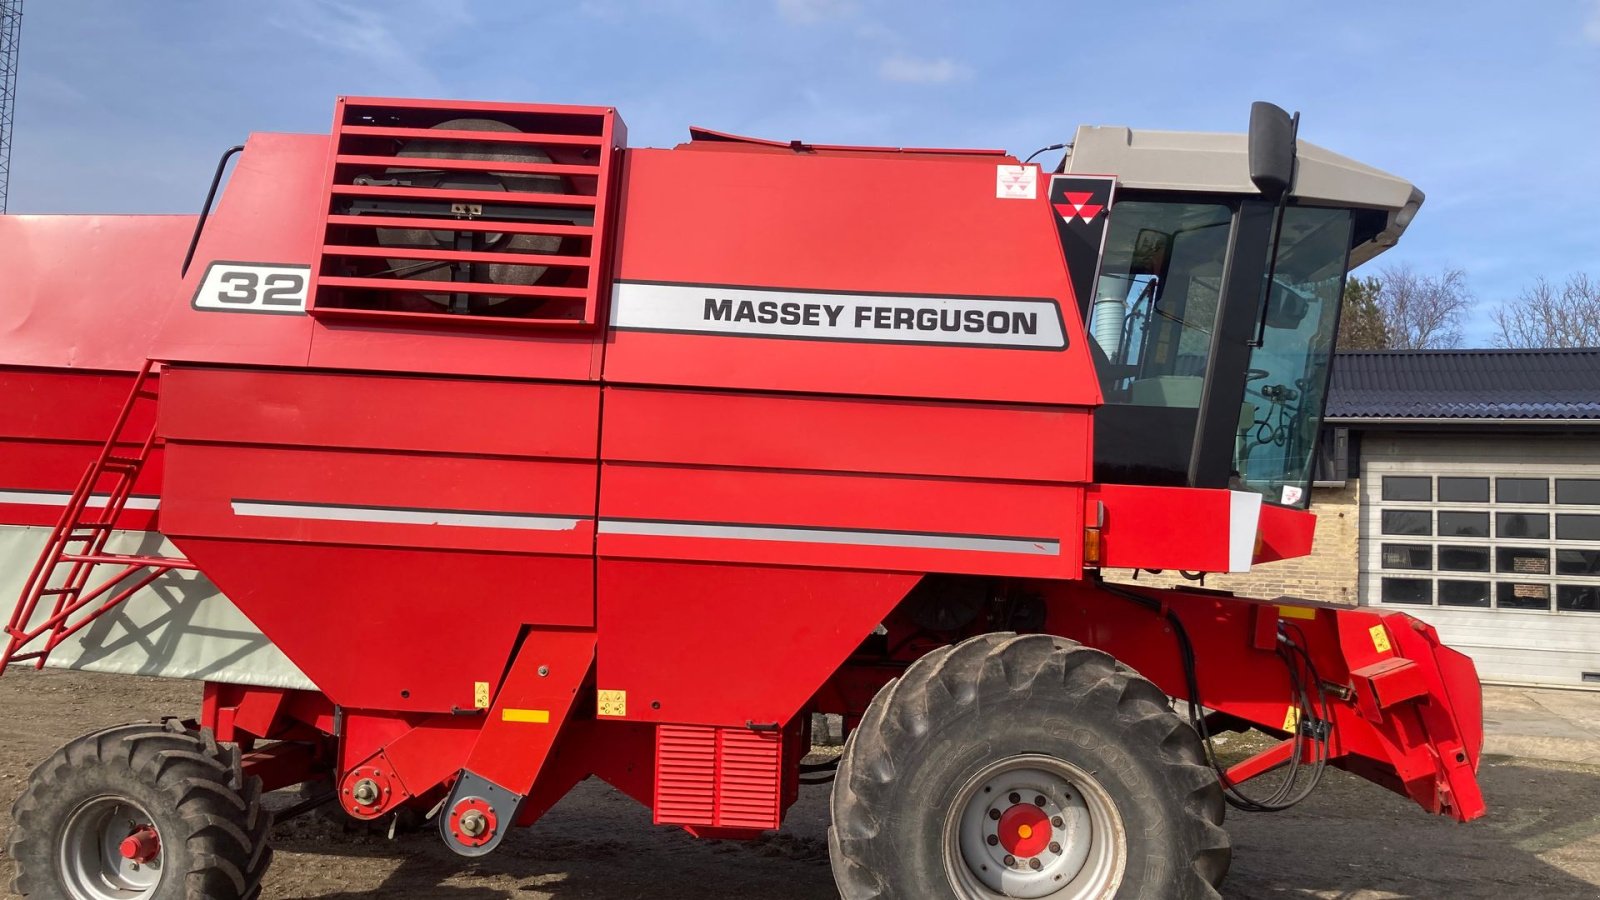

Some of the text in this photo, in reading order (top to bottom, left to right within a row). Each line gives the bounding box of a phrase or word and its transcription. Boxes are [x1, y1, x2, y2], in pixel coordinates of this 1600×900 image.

[218, 271, 304, 306] 32
[703, 298, 1038, 335] MASSEY FERGUSON
[1043, 718, 1168, 900] GOODYE
